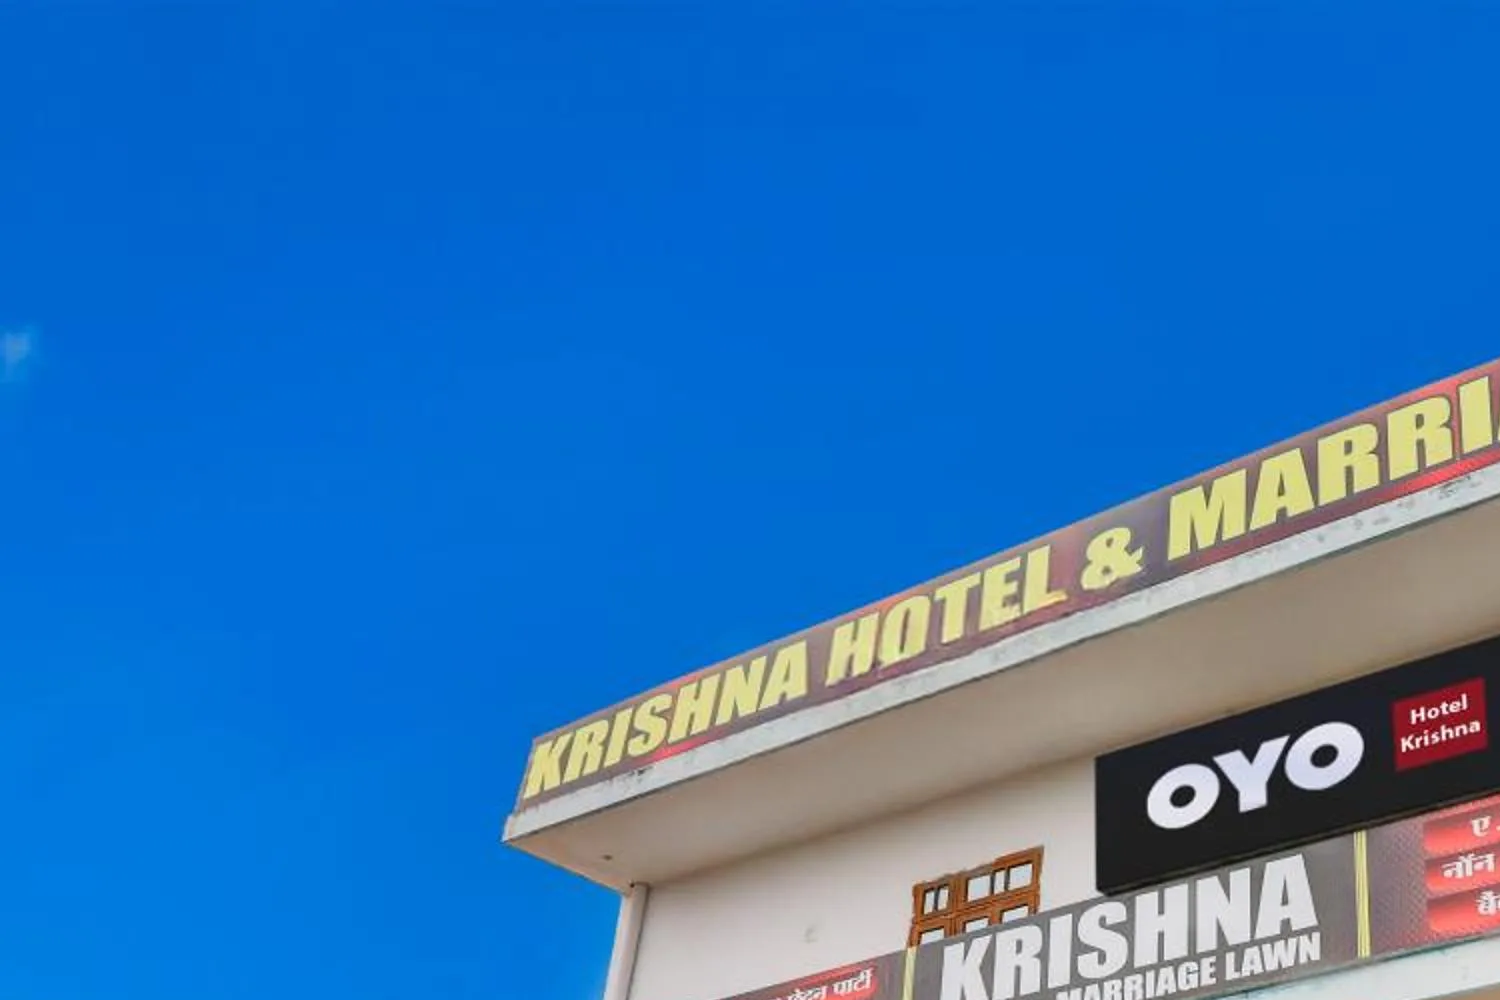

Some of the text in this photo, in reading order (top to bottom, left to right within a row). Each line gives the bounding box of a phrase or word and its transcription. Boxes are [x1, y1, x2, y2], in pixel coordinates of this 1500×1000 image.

[523, 639, 811, 799] KRISHNA
[825, 544, 1067, 687] HOTEL
[1079, 526, 1144, 592] &
[1410, 693, 1468, 725] Hotel
[1400, 720, 1481, 753] Krishna
[1146, 721, 1364, 830] OYO
[1441, 851, 1496, 880] नॉन
[1225, 931, 1322, 981] LAWN
[832, 968, 874, 996] पार्टी
